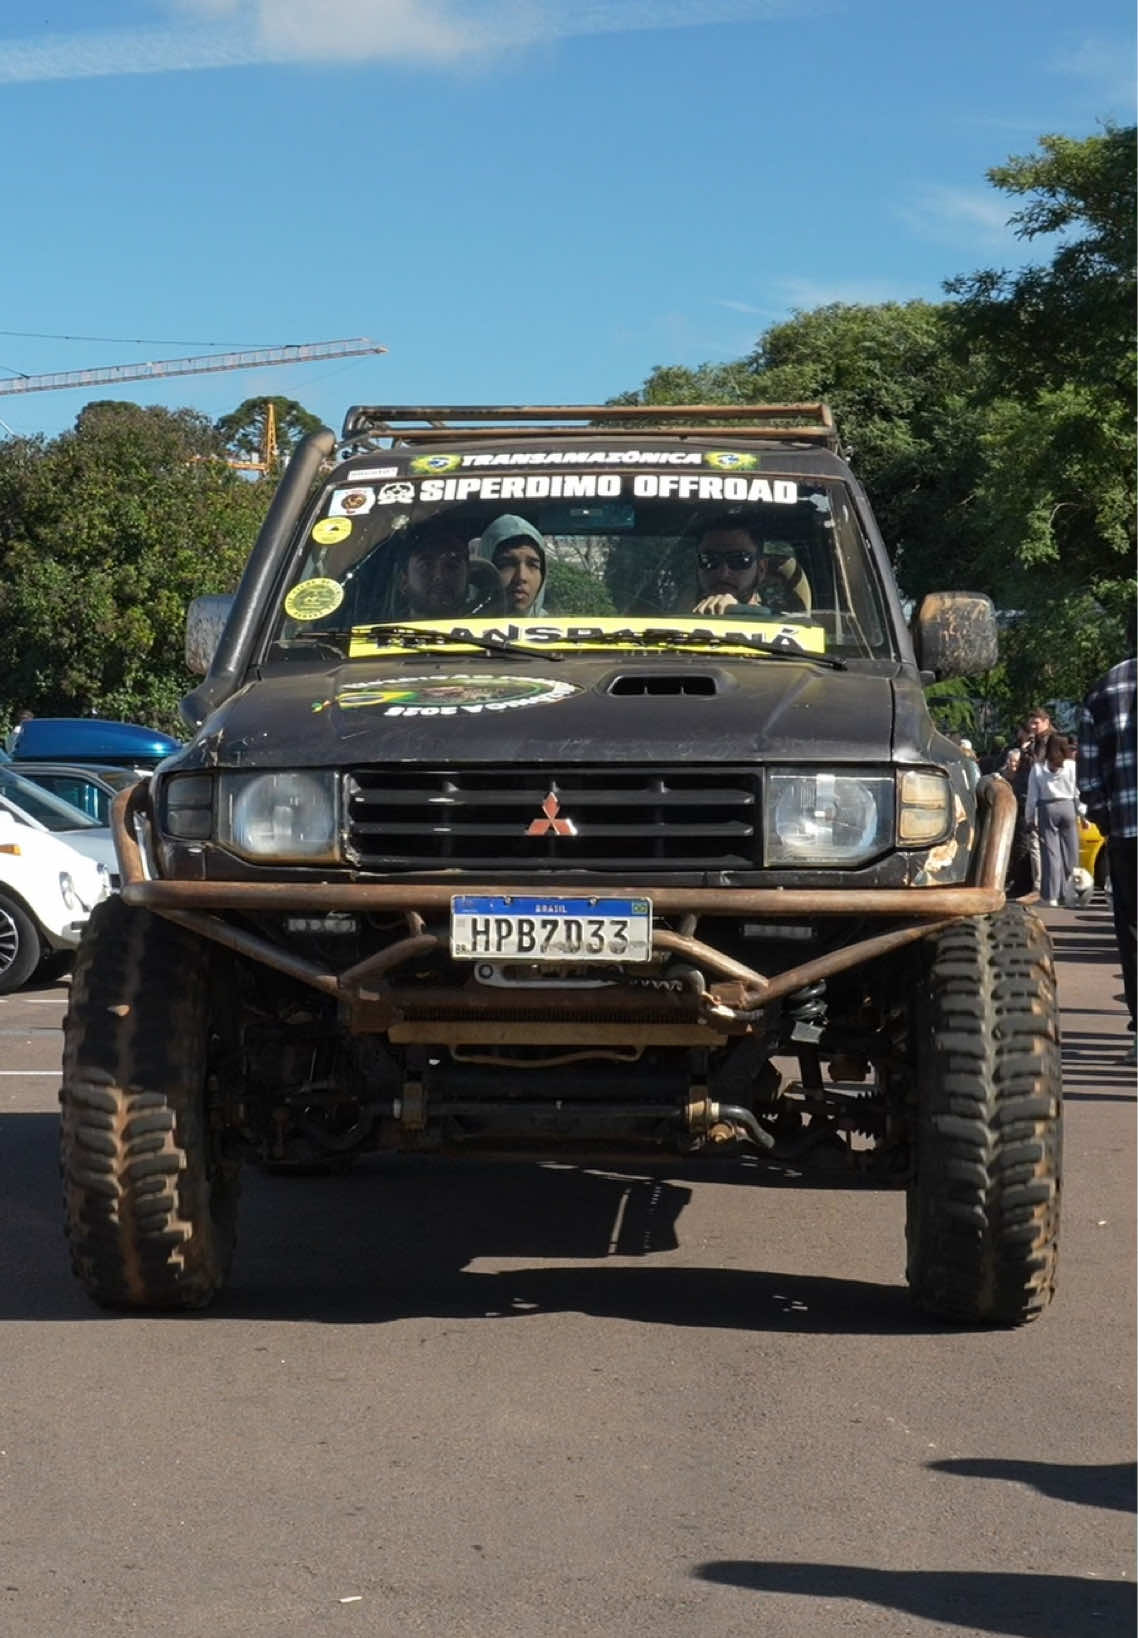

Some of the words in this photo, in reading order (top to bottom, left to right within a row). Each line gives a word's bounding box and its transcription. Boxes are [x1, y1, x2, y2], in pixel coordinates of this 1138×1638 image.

[461, 450, 702, 466] TRANSAMAZÔNICA
[419, 475, 621, 501] SIPERDIMO
[633, 475, 798, 504] OFFROAD
[535, 904, 568, 913] BRASIL
[471, 917, 629, 955] HPB7D33
